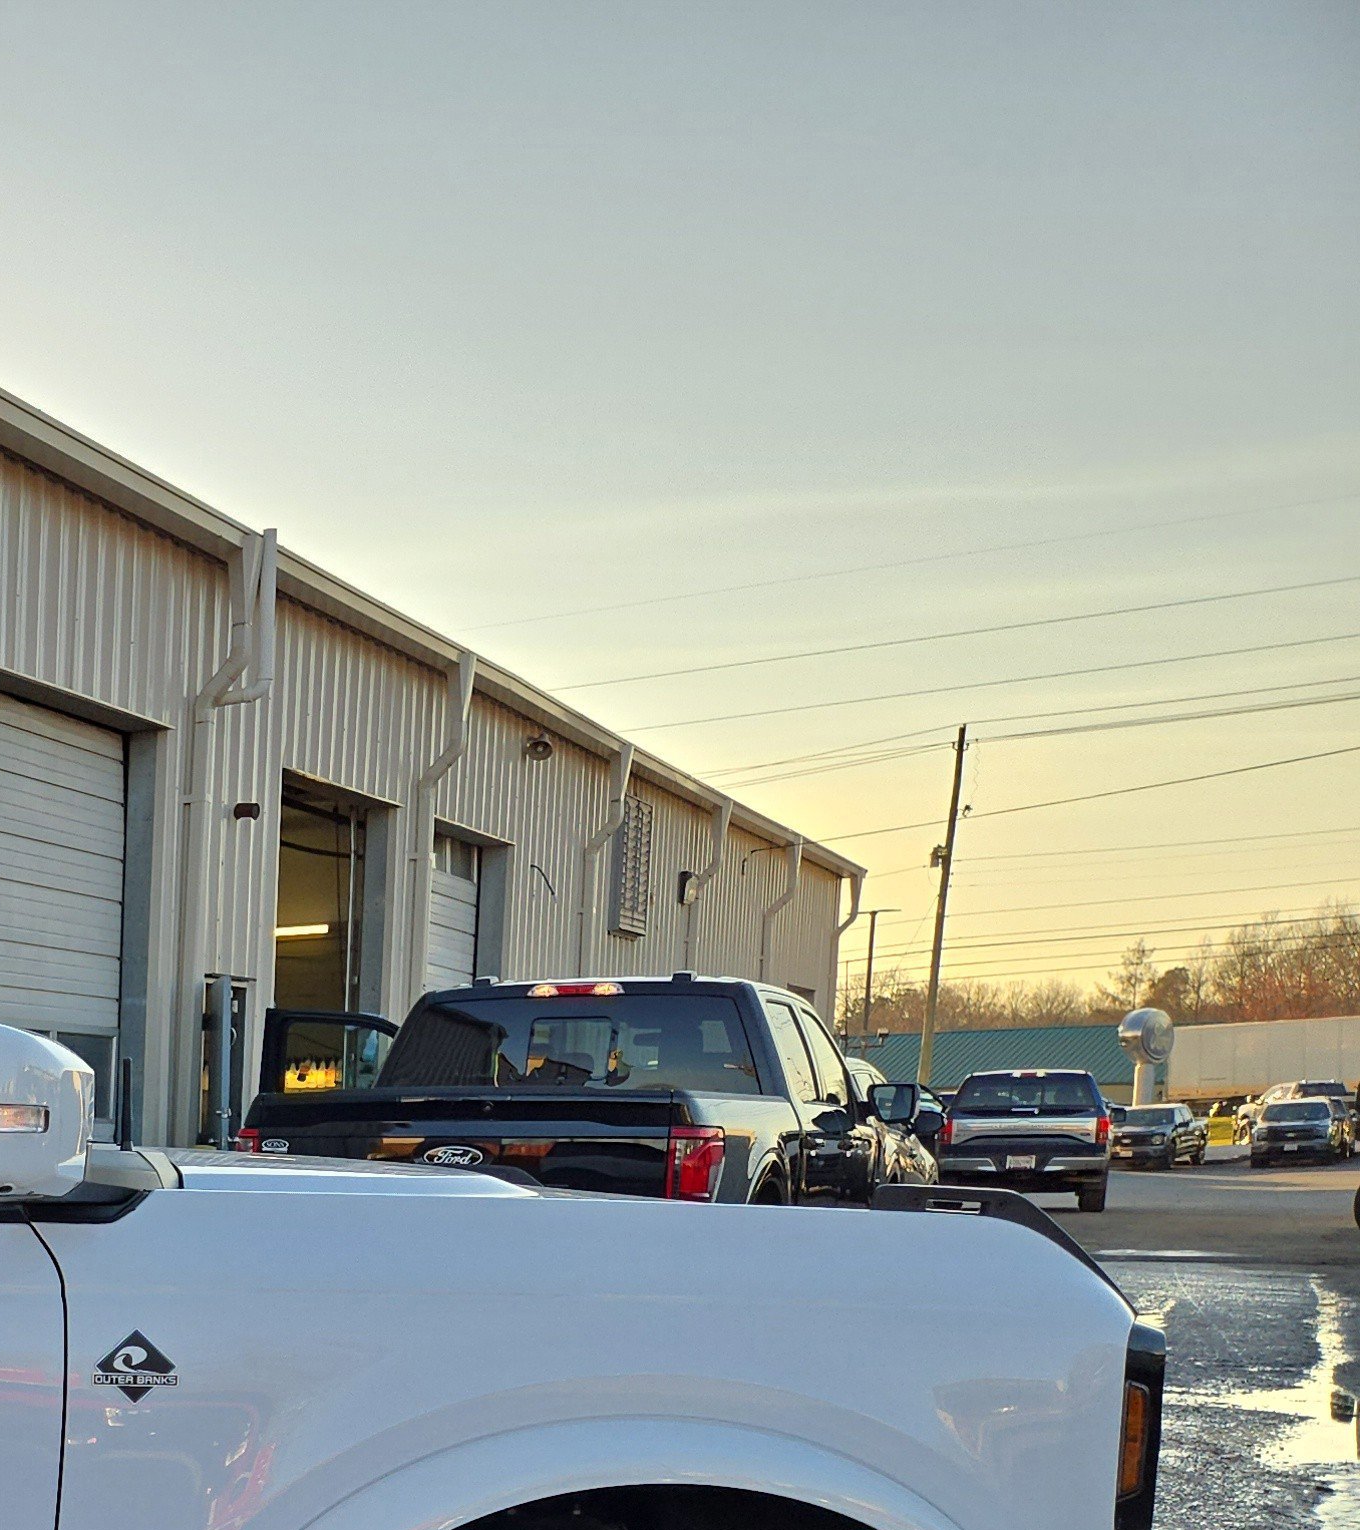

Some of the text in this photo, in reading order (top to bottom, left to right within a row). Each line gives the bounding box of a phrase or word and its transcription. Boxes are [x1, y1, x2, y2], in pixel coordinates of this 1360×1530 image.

[434, 1149, 472, 1165] Ford
[95, 1375, 176, 1385] OUTER BANKS
